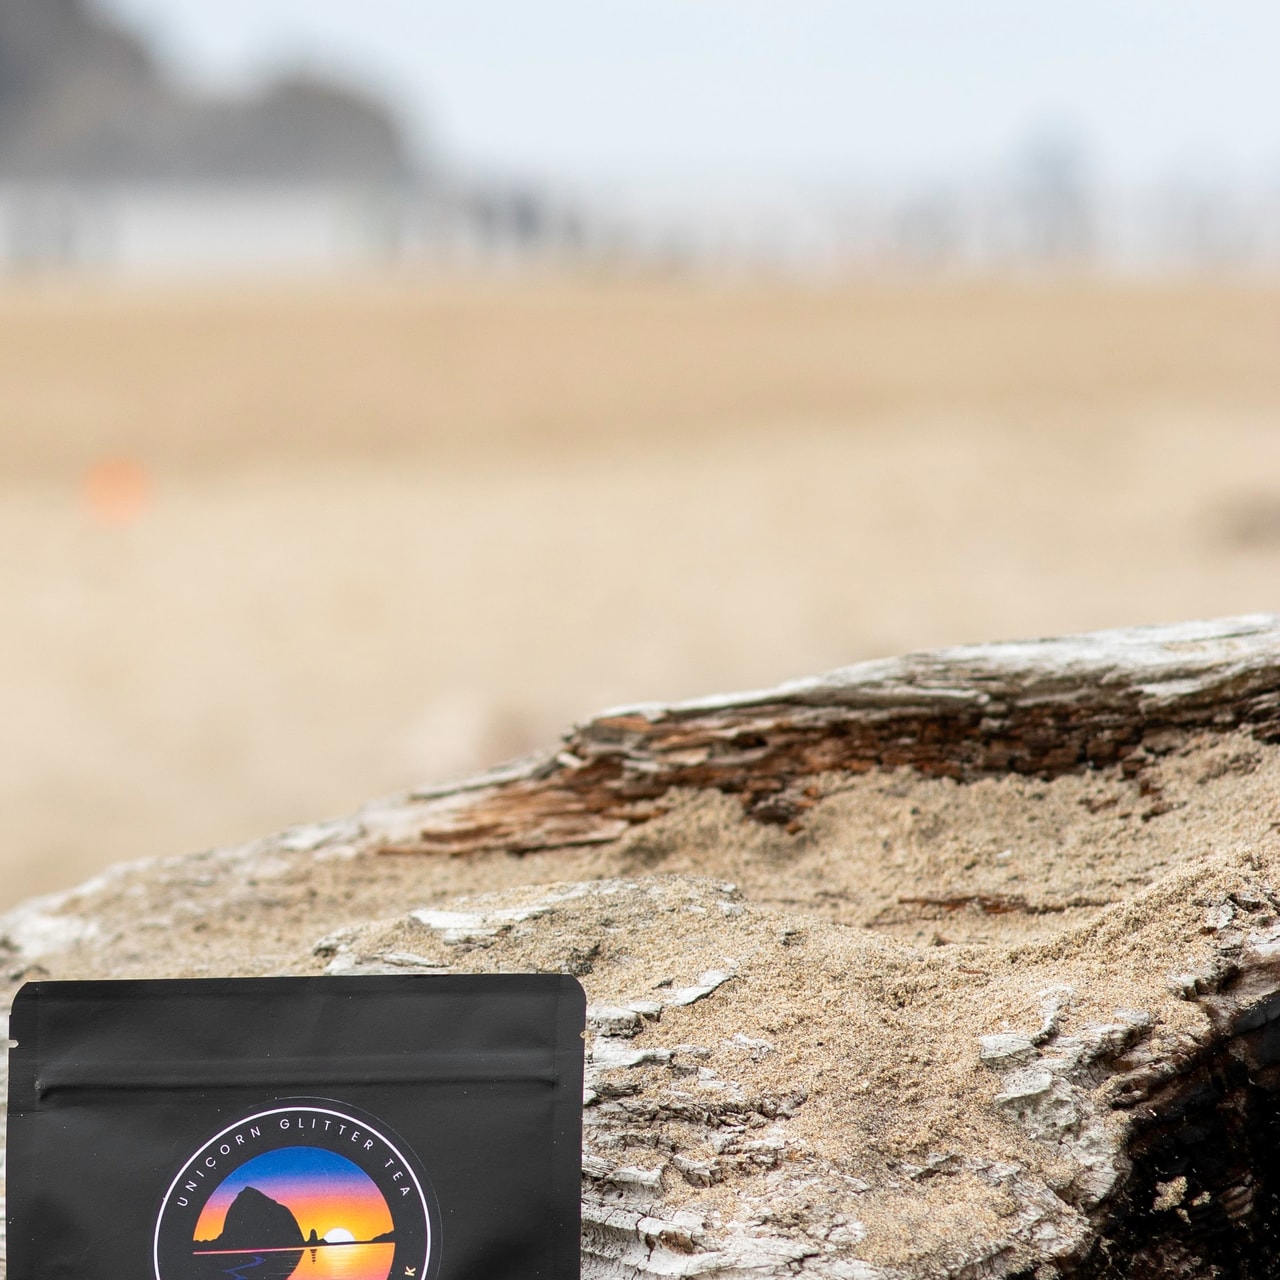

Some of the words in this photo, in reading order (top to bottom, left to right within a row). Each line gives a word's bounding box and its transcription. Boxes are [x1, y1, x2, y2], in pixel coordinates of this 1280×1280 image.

[176, 1125, 261, 1207] UNICORN
[279, 1117, 374, 1151] GLITTER
[384, 1157, 411, 1197] TEA
